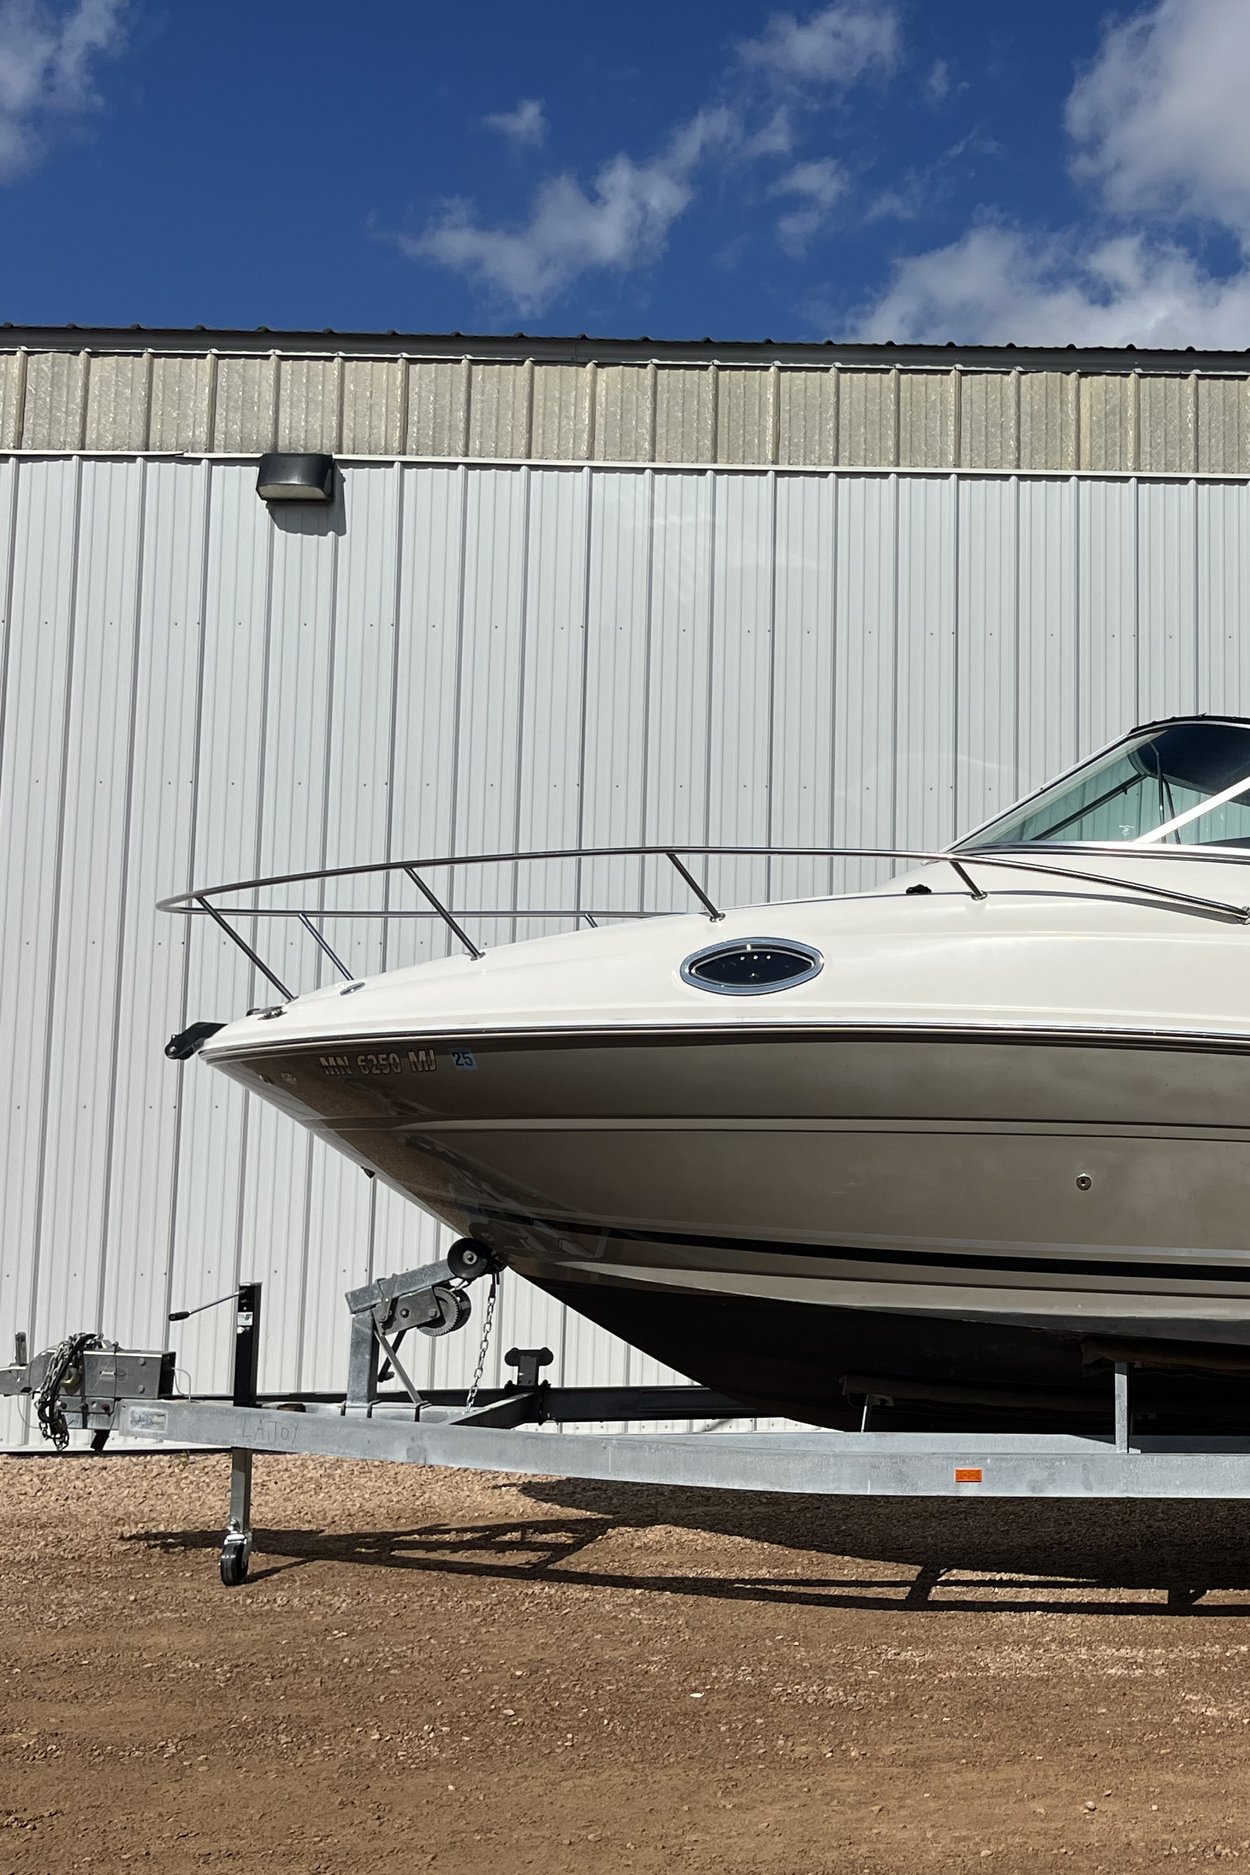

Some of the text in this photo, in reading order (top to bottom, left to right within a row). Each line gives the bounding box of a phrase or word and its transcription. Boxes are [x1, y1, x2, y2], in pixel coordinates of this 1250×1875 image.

[318, 1056, 352, 1075] MN
[407, 1049, 438, 1073] MJ
[451, 1051, 474, 1067] 25
